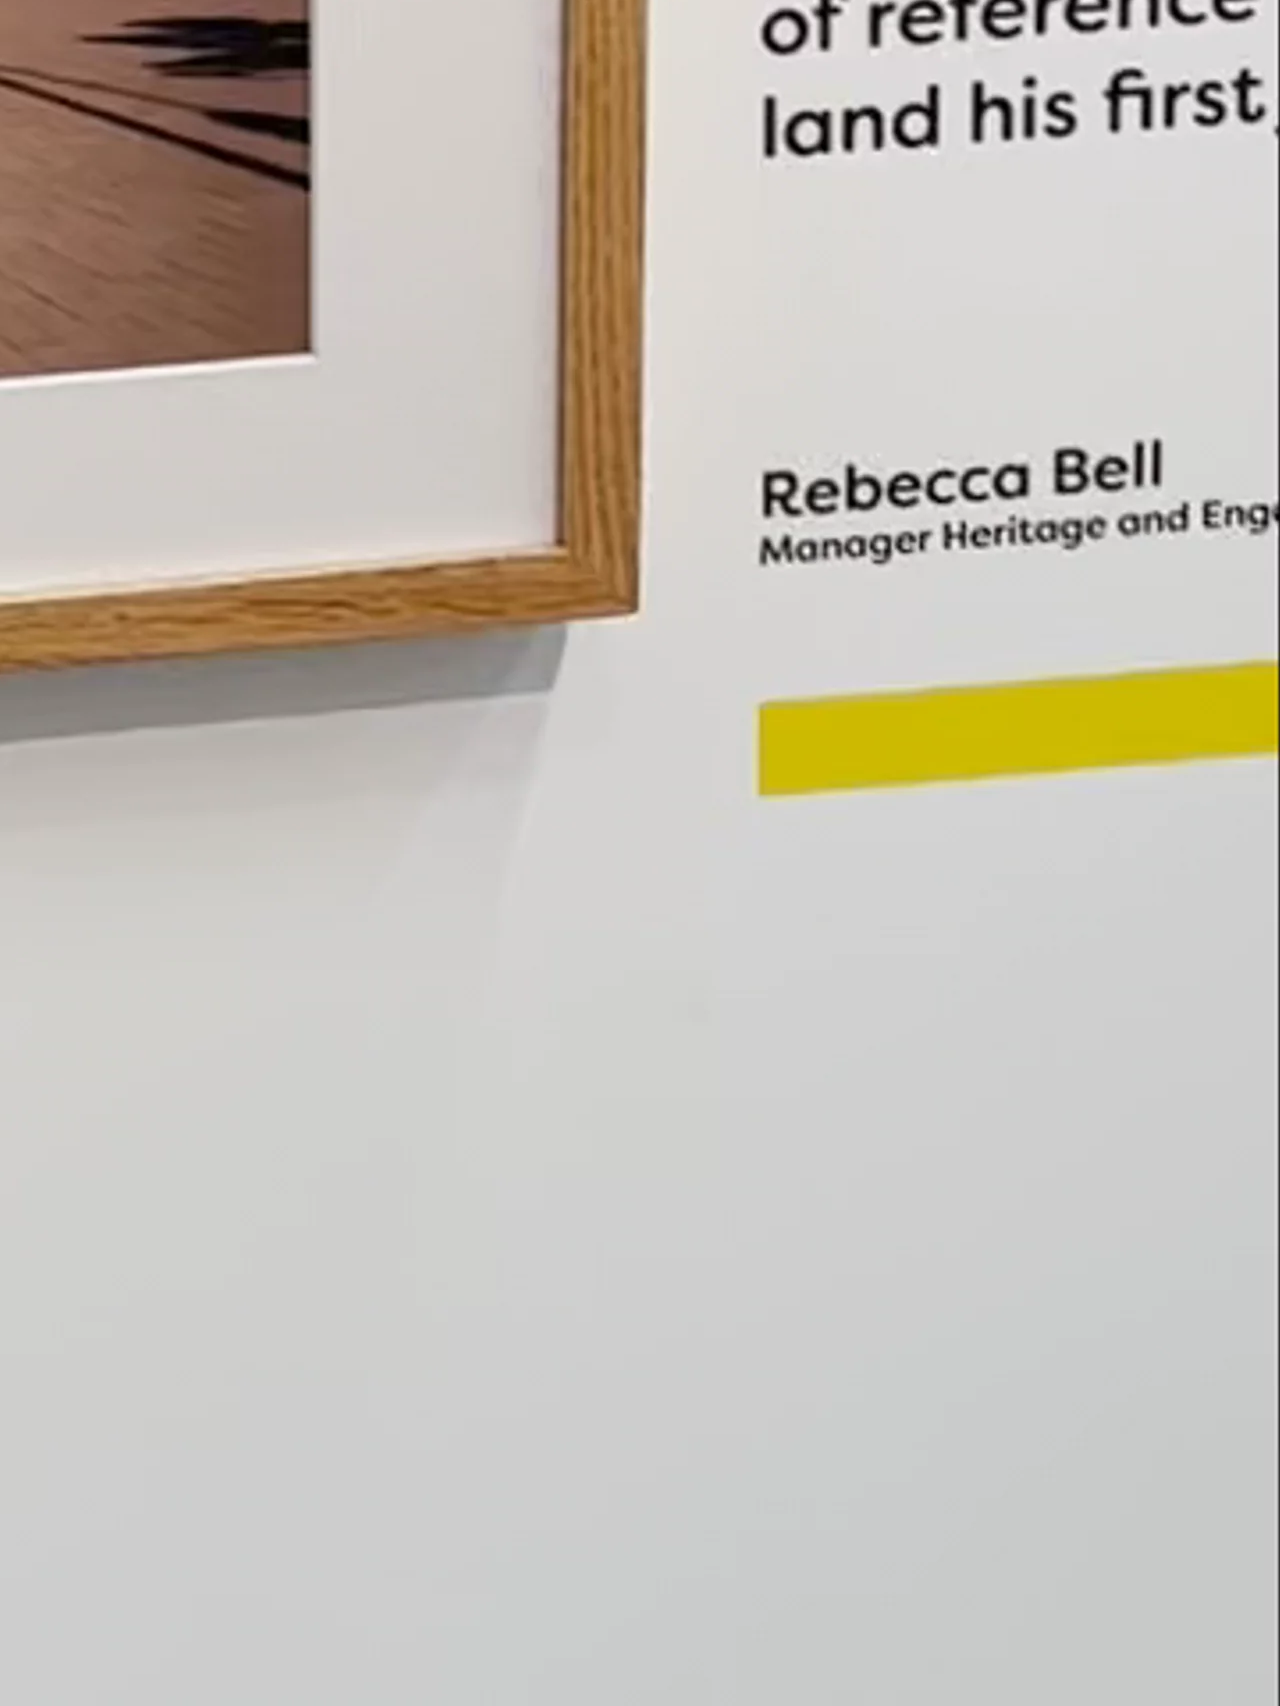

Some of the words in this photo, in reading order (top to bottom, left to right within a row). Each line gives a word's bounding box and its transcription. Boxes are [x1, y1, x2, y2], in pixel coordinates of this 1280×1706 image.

[763, 83, 940, 159] land
[971, 76, 1077, 144] his
[1102, 67, 1266, 134] first
[762, 463, 1030, 519] Rebecca
[1053, 438, 1162, 496] Bell
[759, 530, 933, 566] Manager
[942, 515, 1107, 550] Heritage
[1117, 502, 1190, 537] and
